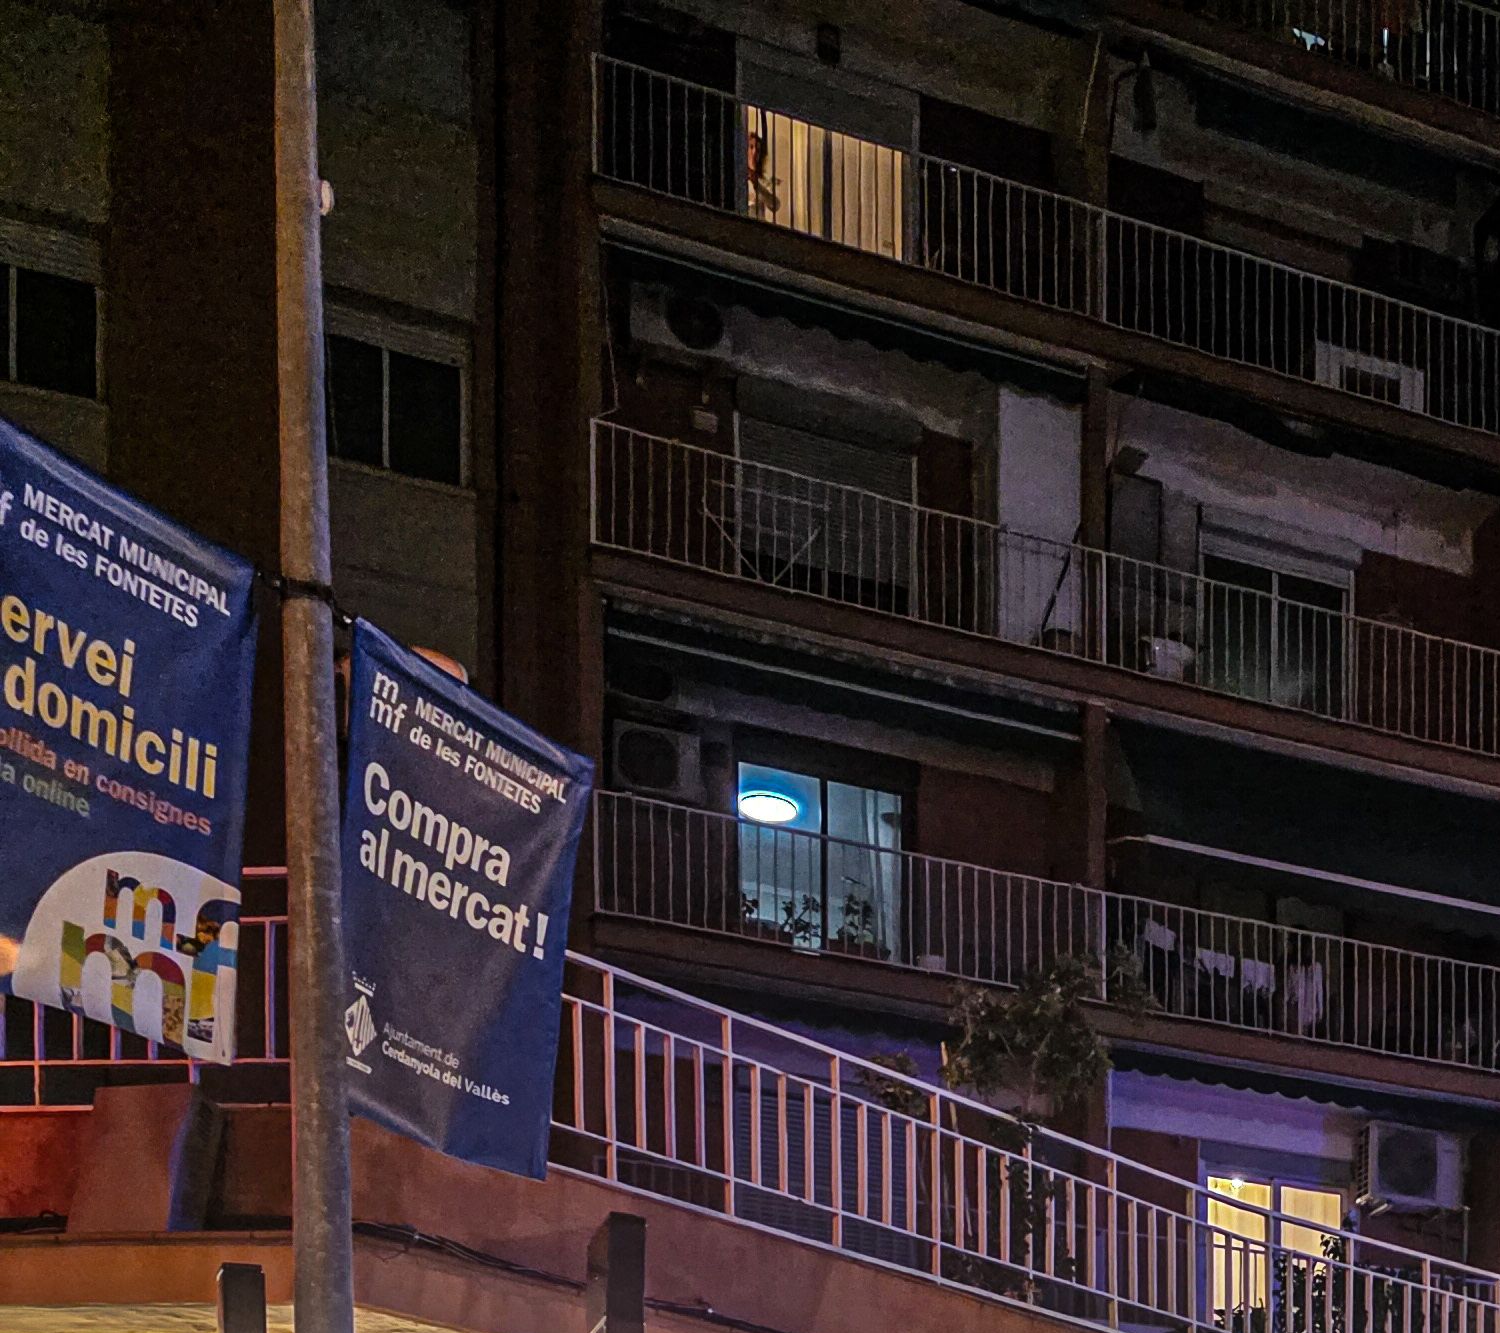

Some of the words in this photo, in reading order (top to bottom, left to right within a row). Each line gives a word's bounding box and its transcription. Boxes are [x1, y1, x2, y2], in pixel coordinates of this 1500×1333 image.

[20, 518, 49, 548] de
[55, 533, 88, 569] les
[95, 554, 199, 628] FONTETES
[23, 483, 115, 550] MERCAT
[119, 535, 231, 617] MUNICIPAL
[4, 657, 218, 799] domicili
[409, 725, 432, 750] de
[435, 737, 461, 768] les
[464, 754, 542, 815] FONTETES
[414, 697, 486, 751] MERCAT
[485, 739, 567, 804] MUNICIPAL
[22, 773, 91, 819] online
[63, 759, 91, 786] en
[95, 773, 212, 837] consignes
[363, 761, 511, 887] Compra
[381, 1040, 441, 1082] Cerdanyola
[442, 1070, 462, 1090] del
[464, 1077, 511, 1106] Vallès
[383, 1021, 444, 1062] Ajuntament
[443, 1052, 461, 1070] de
